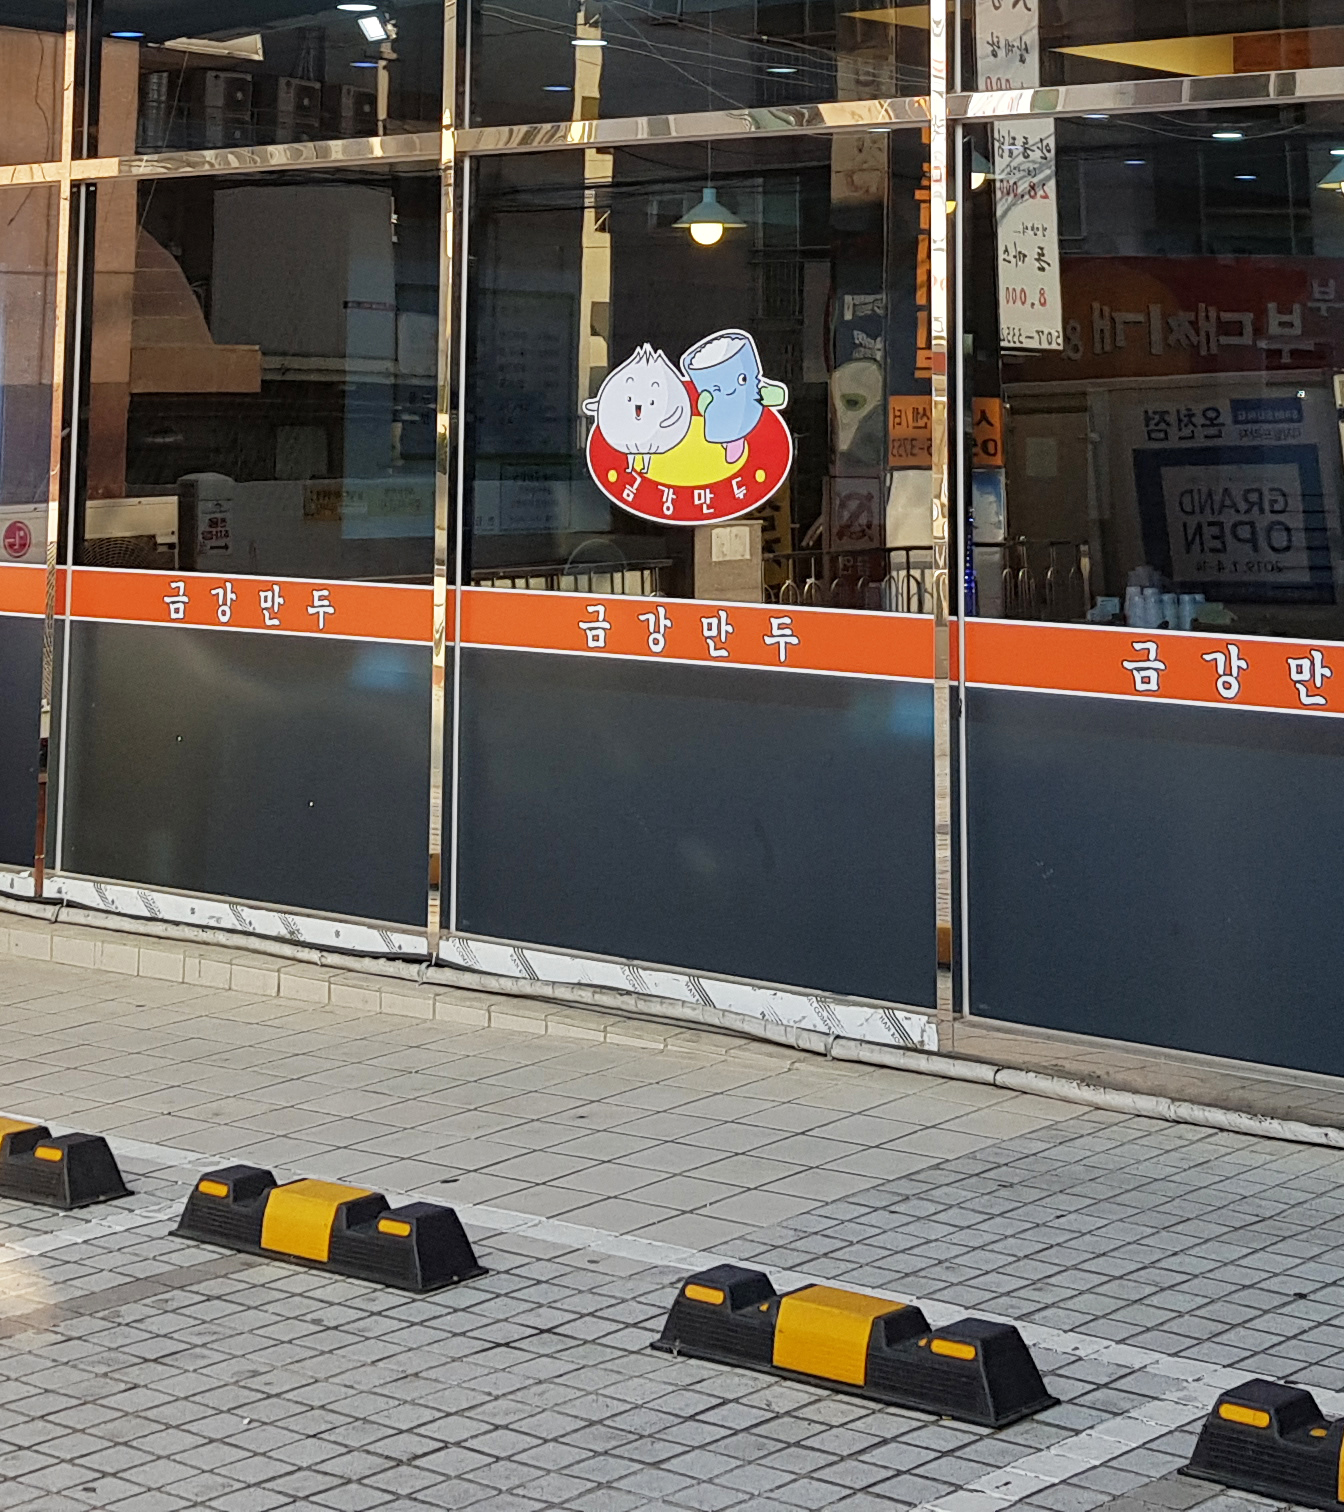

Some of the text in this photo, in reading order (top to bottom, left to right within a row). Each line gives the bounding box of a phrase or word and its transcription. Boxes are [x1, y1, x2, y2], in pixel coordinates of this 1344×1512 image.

[622, 469, 750, 517] 금강만두
[163, 580, 336, 632] 금강만두
[579, 603, 801, 663] 금강만두
